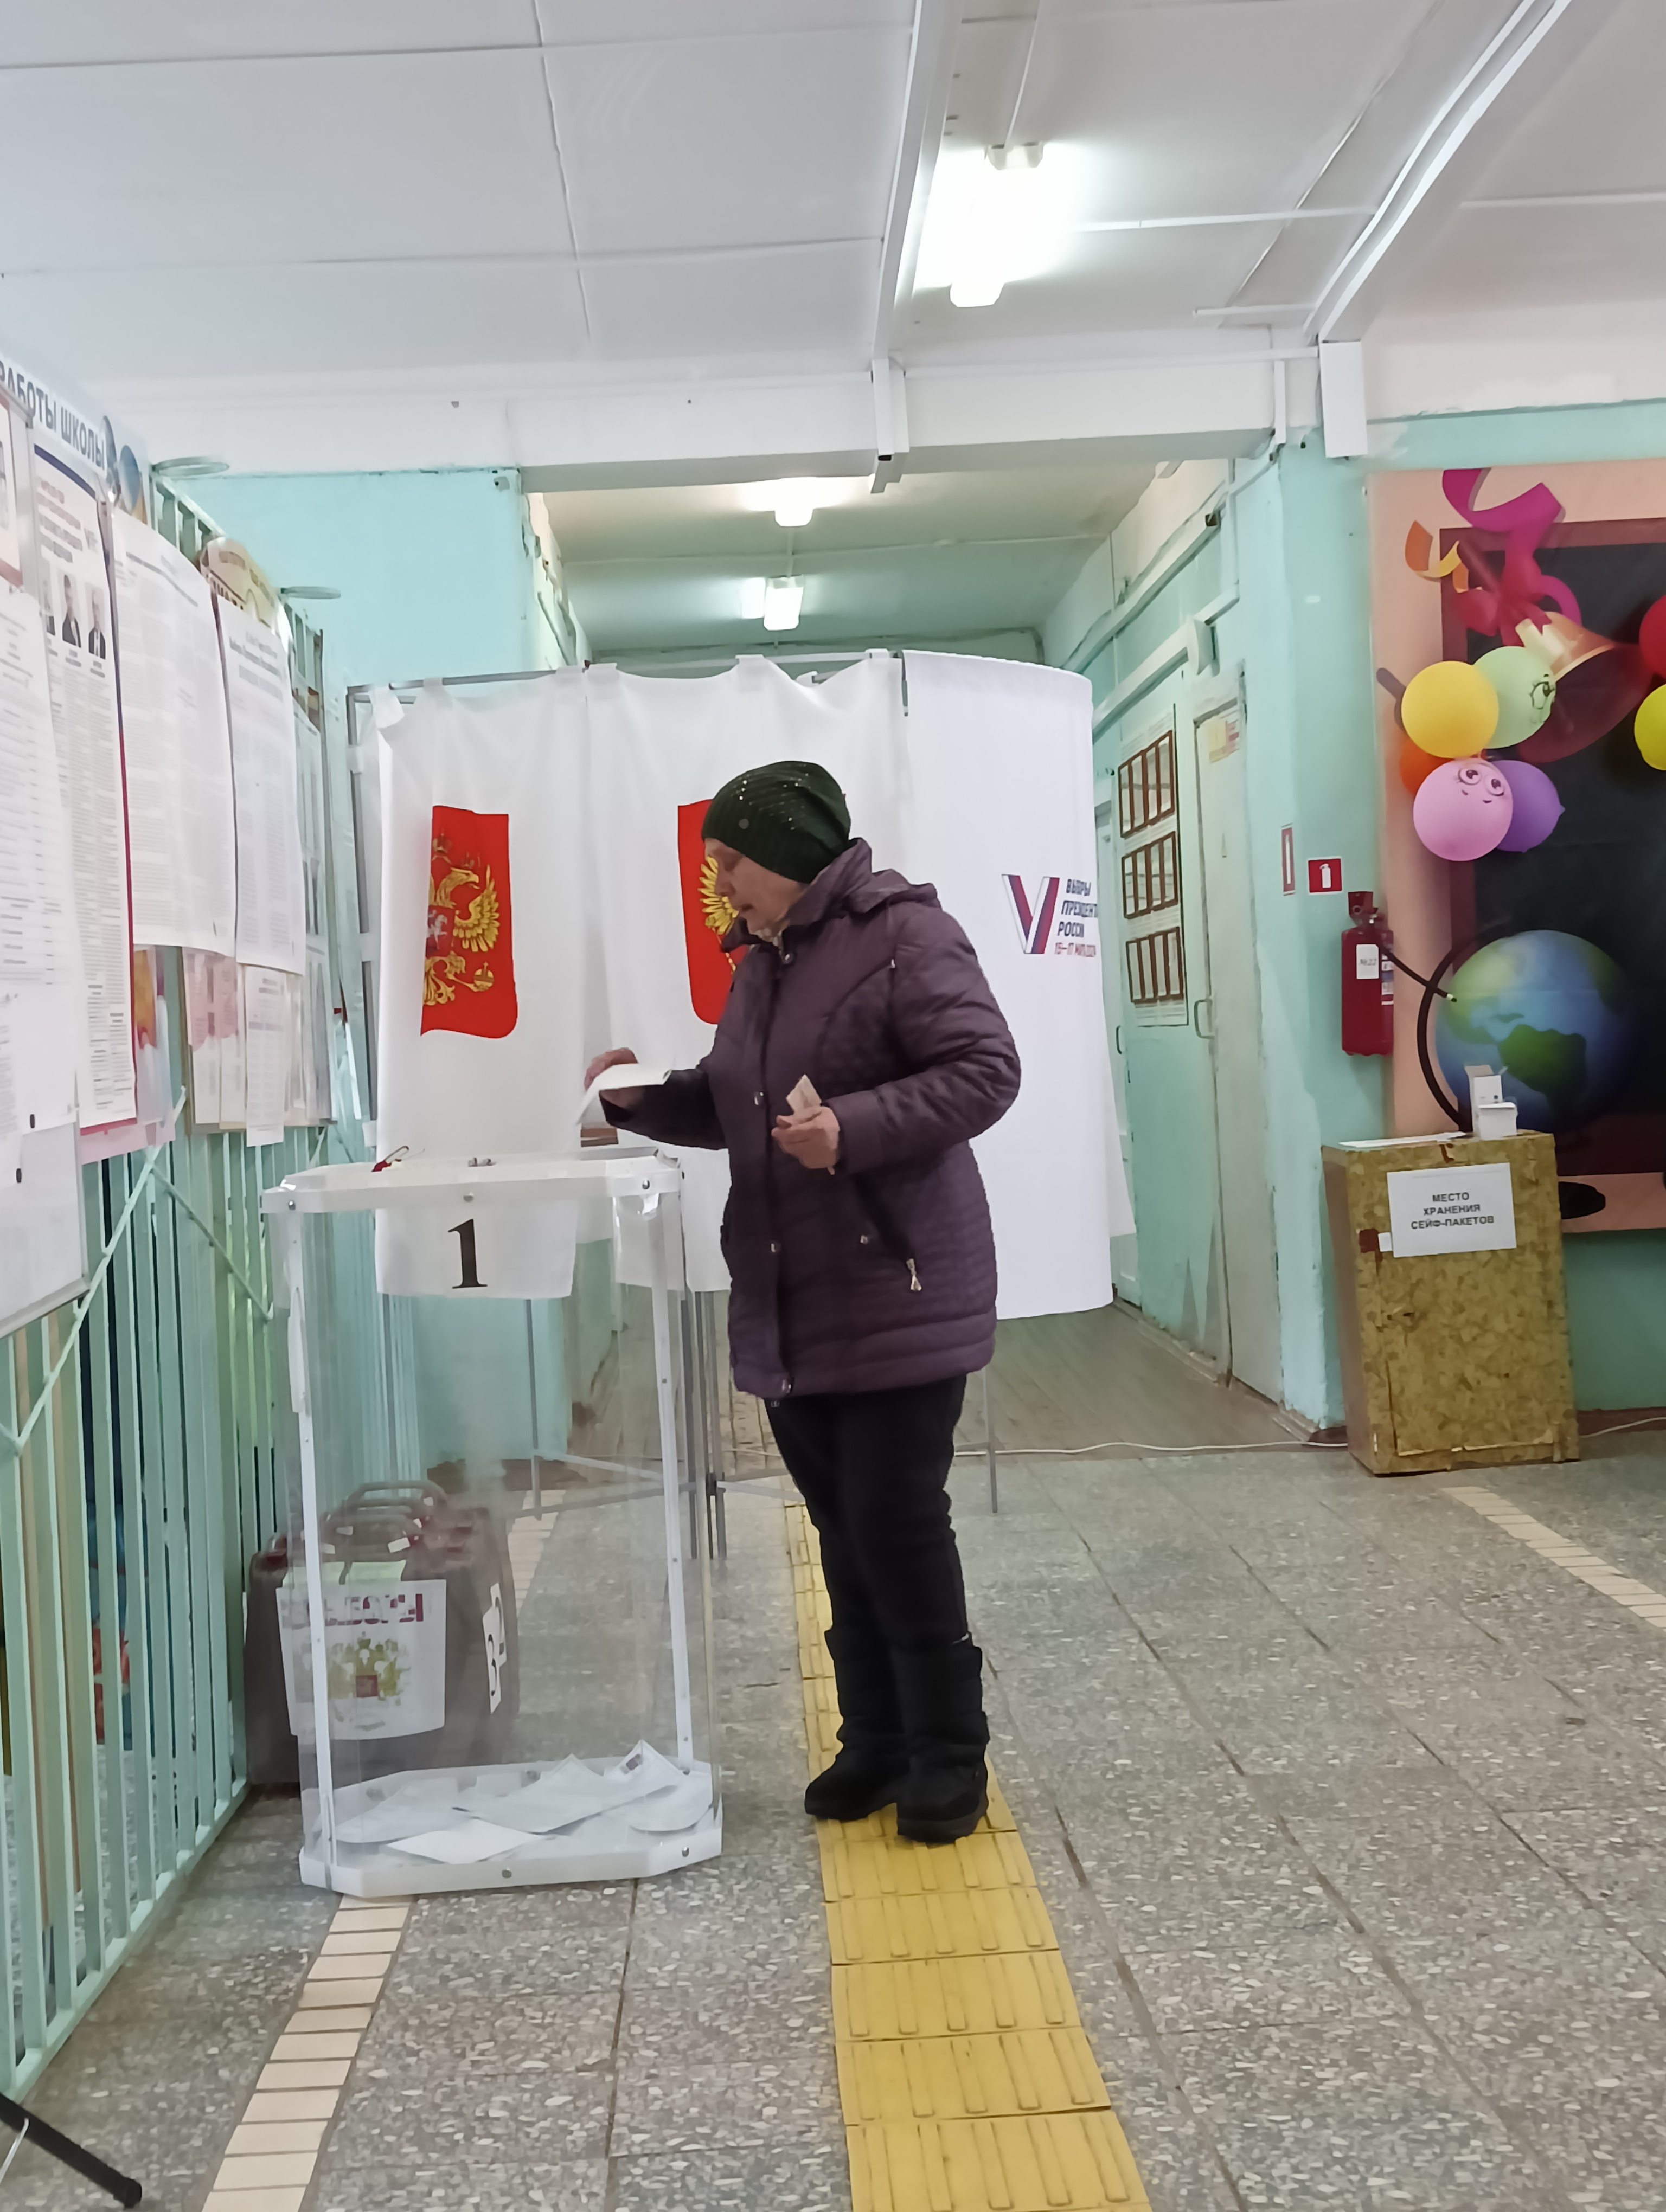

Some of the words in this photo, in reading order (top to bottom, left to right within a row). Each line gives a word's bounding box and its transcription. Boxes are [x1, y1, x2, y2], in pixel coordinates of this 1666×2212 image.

[61, 406, 105, 471] ШКОЛЫ
[1432, 1192, 1470, 1203] МЕСТО
[1423, 1204, 1481, 1216] ХРАНЕНИЯ
[1411, 1216, 1495, 1229] СЕЙФ-ПАКЕТОВ
[447, 1218, 488, 1289] 1
